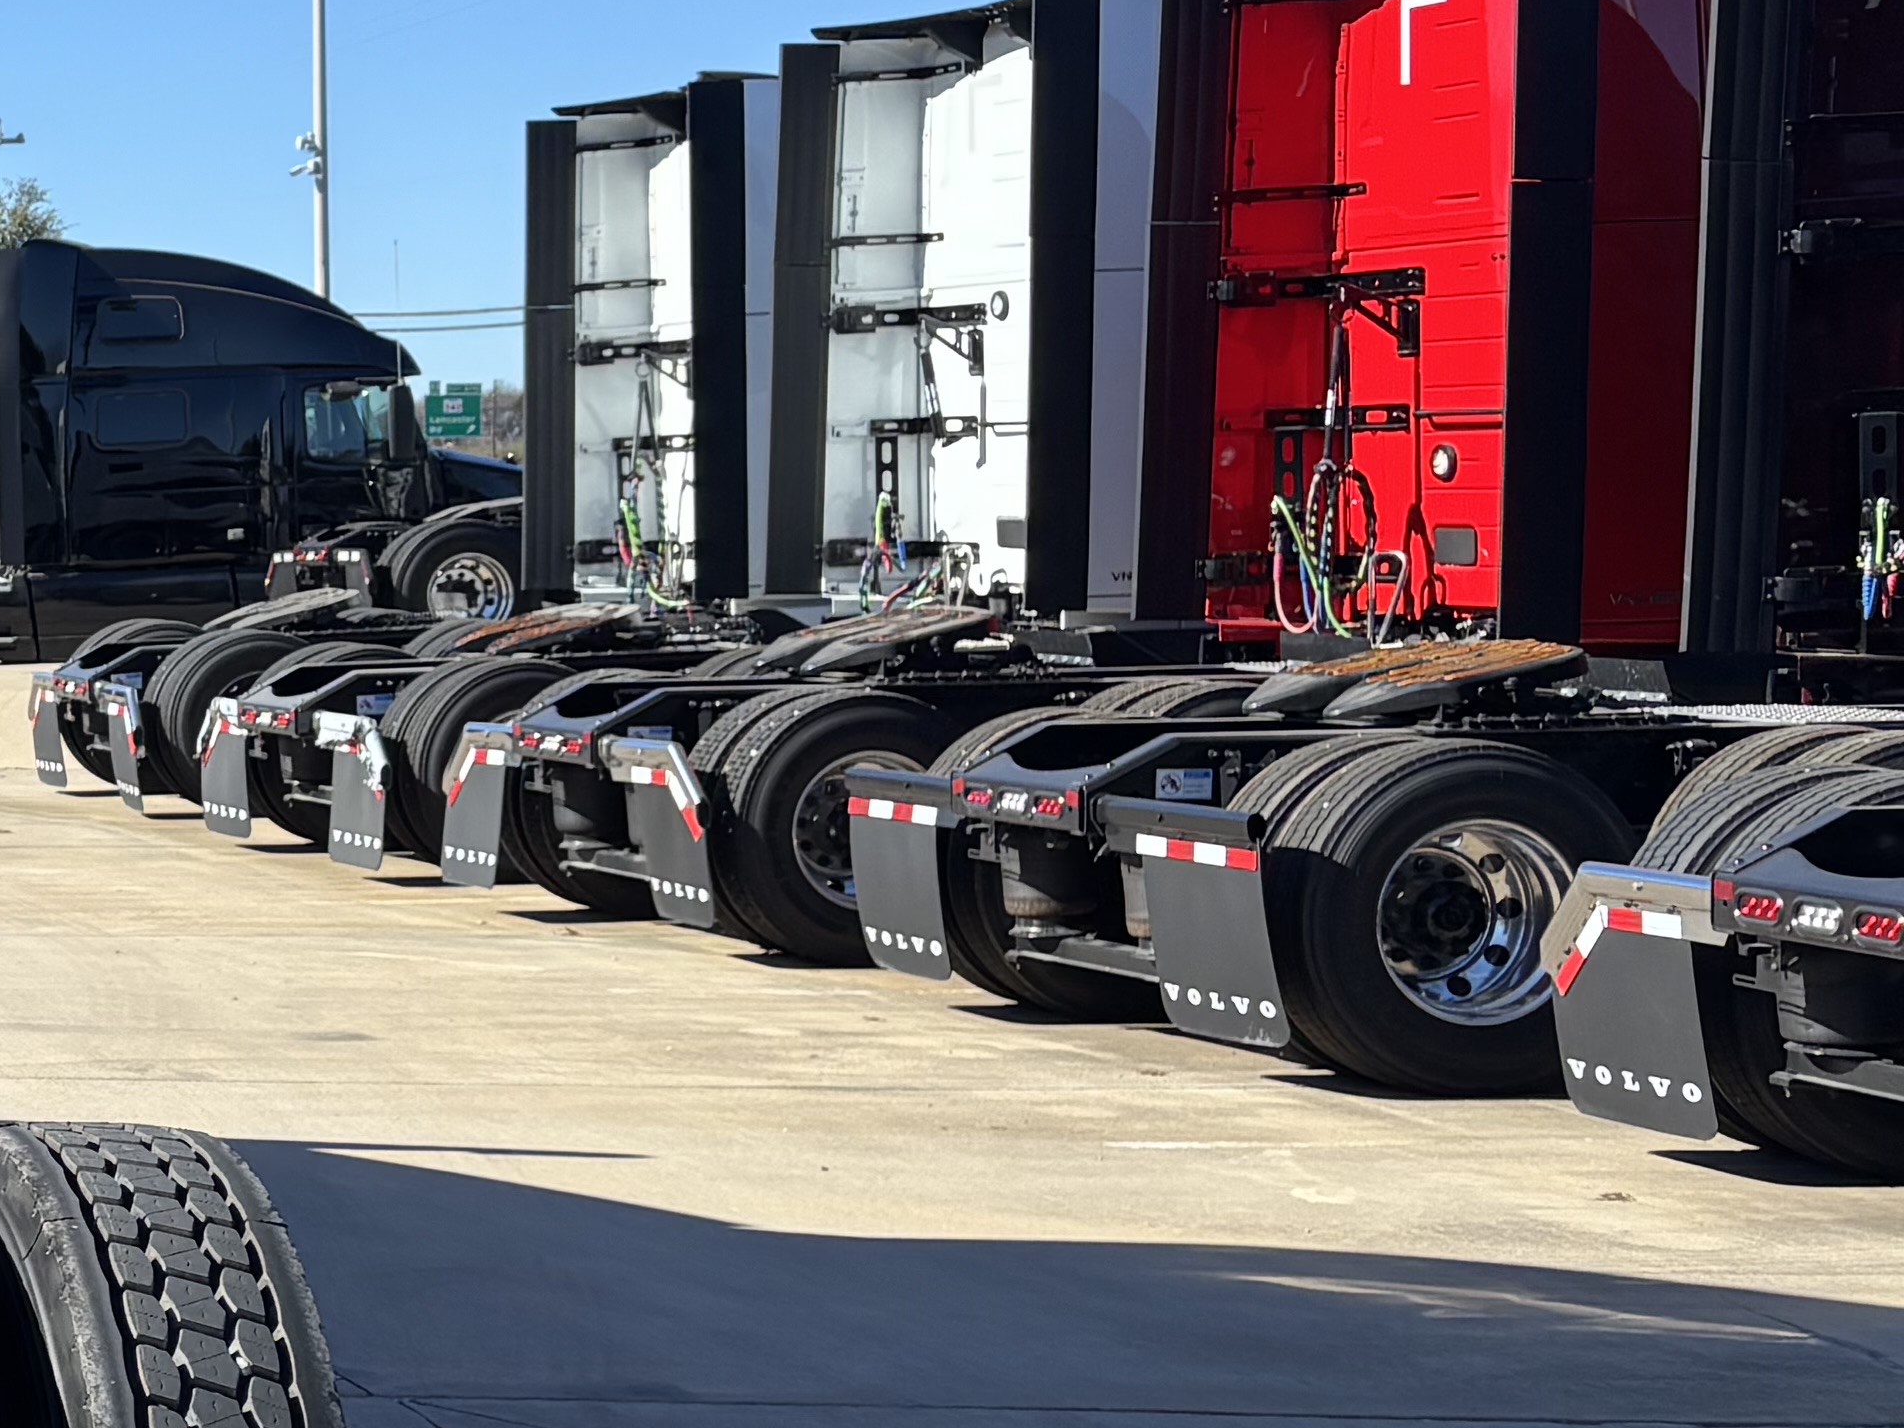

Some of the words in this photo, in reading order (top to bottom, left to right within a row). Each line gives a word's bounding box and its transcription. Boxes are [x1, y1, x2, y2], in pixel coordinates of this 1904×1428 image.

[36, 759, 63, 773] VOLVO
[203, 800, 247, 821] VOLVO
[333, 829, 382, 850] VOLVO
[444, 846, 496, 867] VOLVO
[650, 877, 710, 903] VOLVO
[865, 926, 943, 957] VOLVO
[1163, 982, 1277, 1019] VOLVO
[1566, 1057, 1703, 1103] VOLVO
